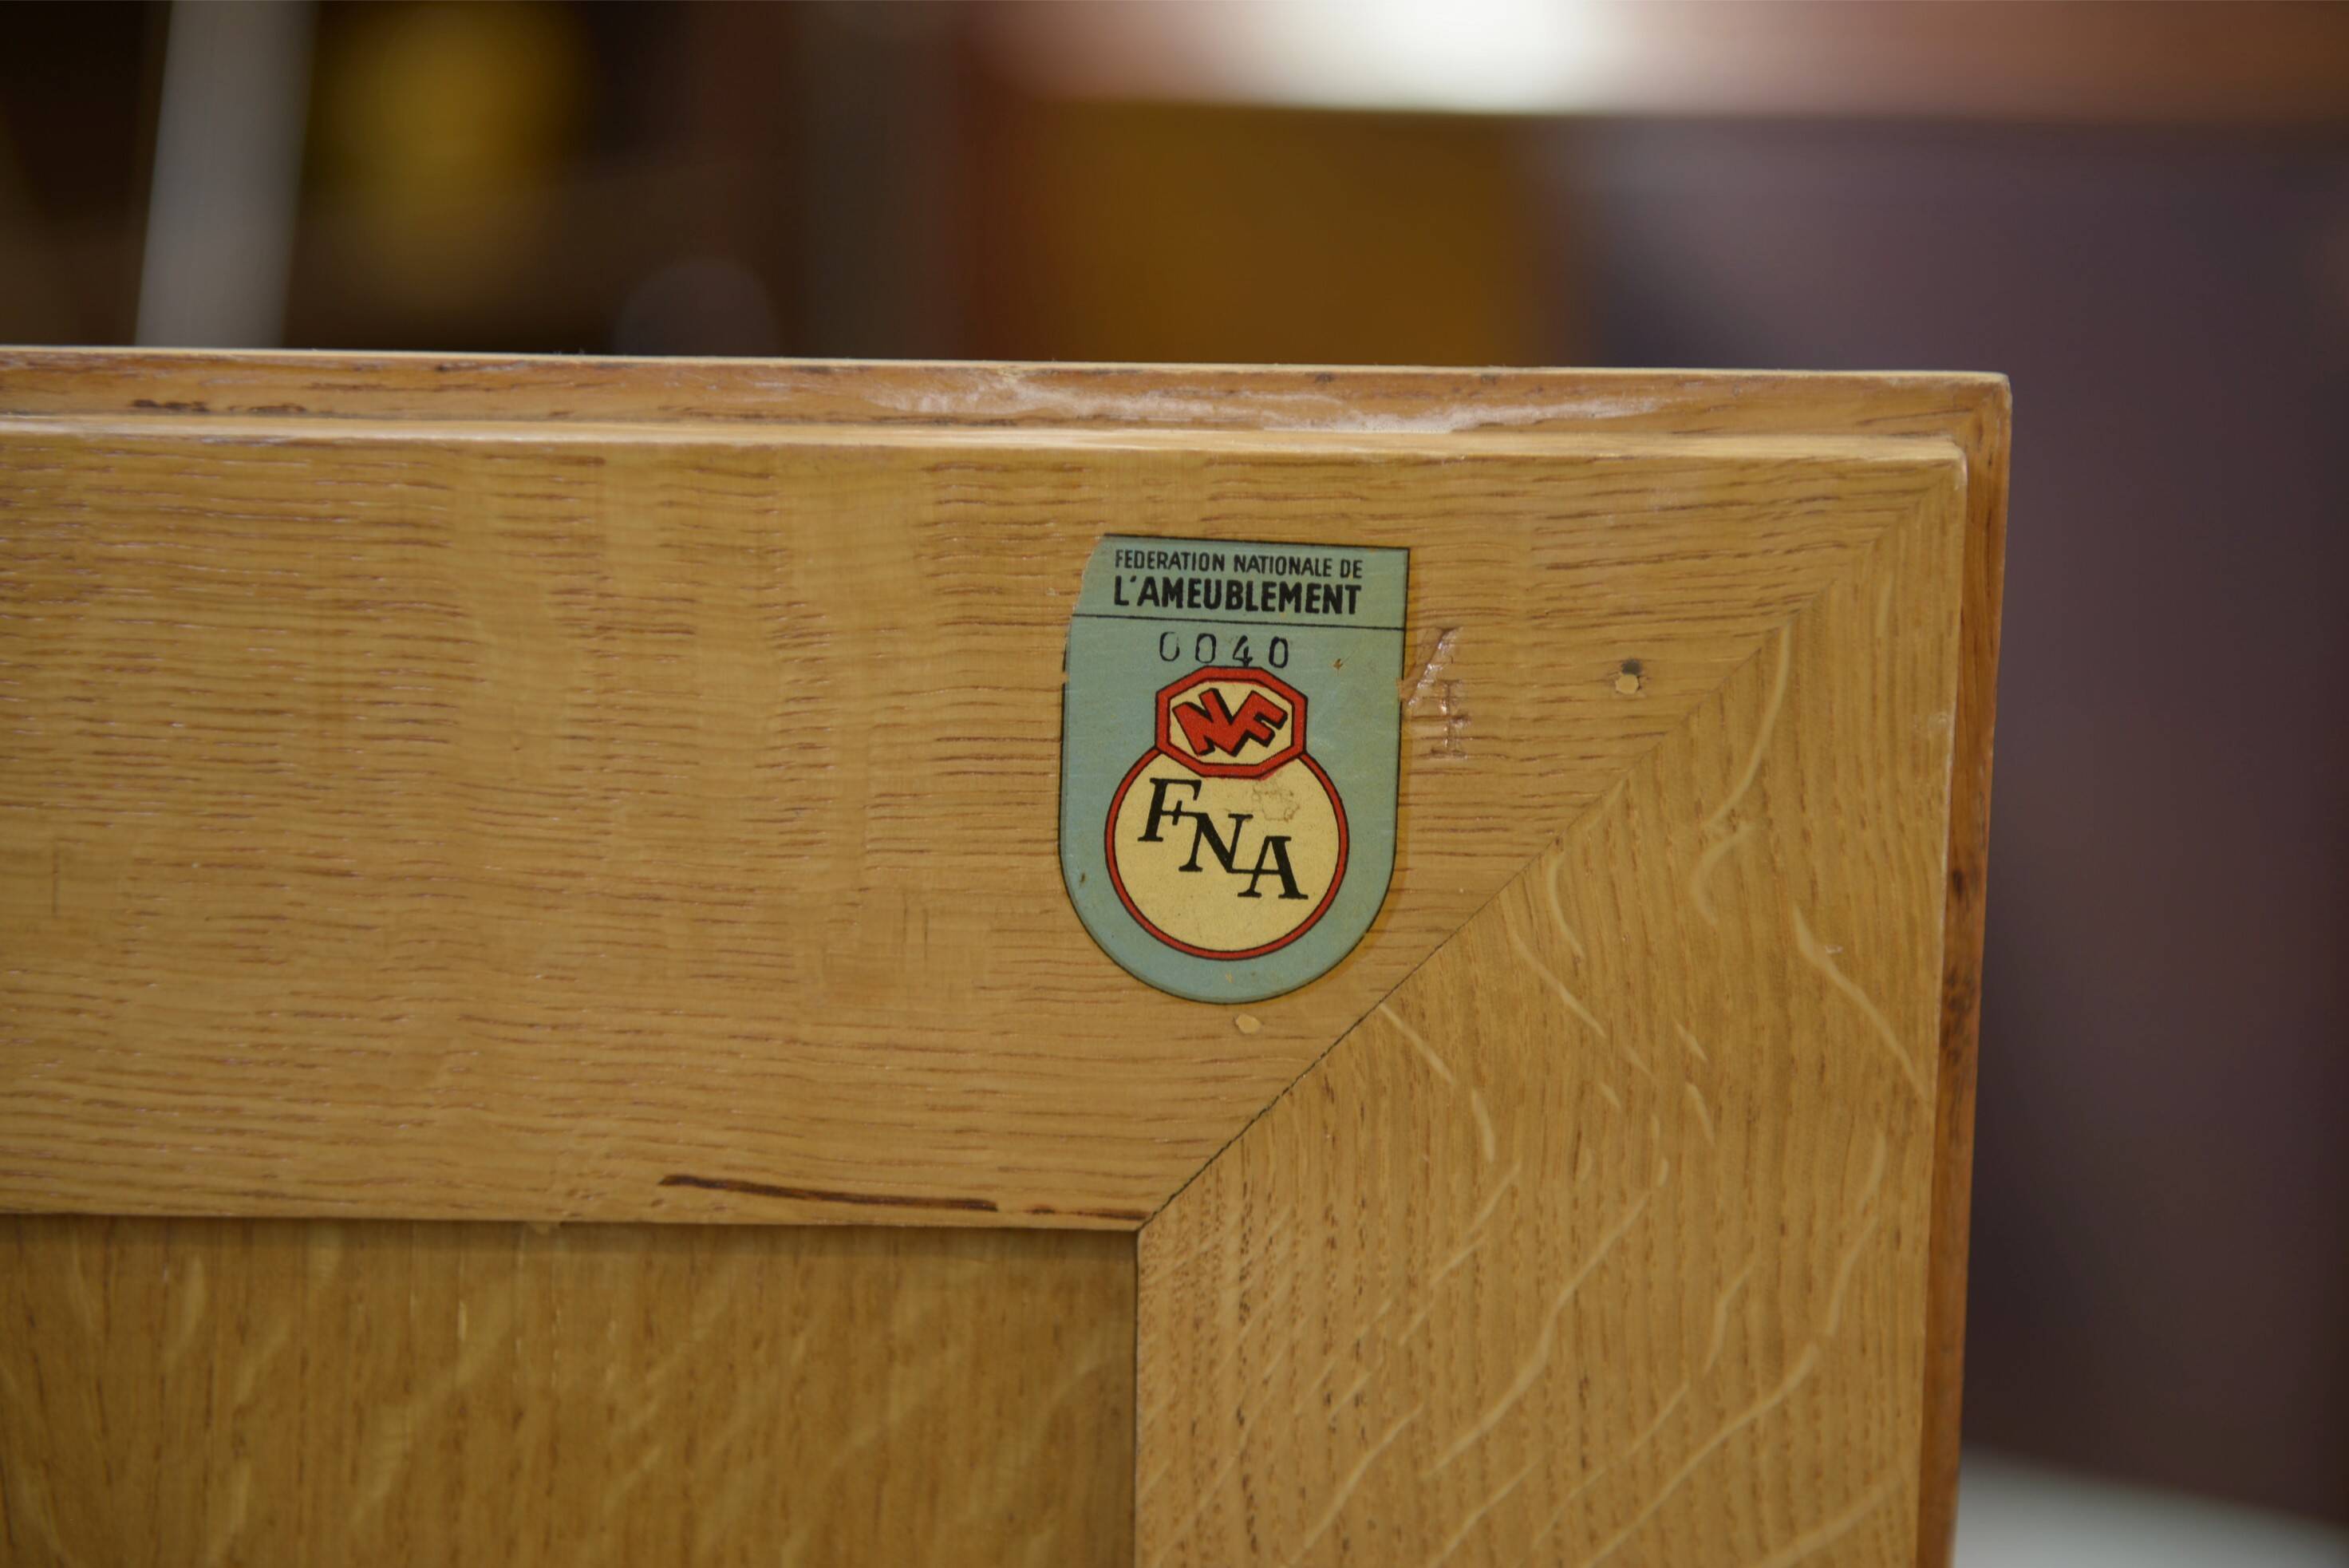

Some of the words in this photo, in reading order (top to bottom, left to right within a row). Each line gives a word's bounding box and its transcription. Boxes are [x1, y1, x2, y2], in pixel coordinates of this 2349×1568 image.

[1115, 549, 1225, 572] FEDERATION
[1234, 555, 1332, 577] NATIONALE
[1340, 559, 1362, 579] DE
[1114, 575, 1362, 614] L'AMEUBLEMENT
[1159, 631, 1289, 668] 0040
[1138, 777, 1309, 899] FNA
